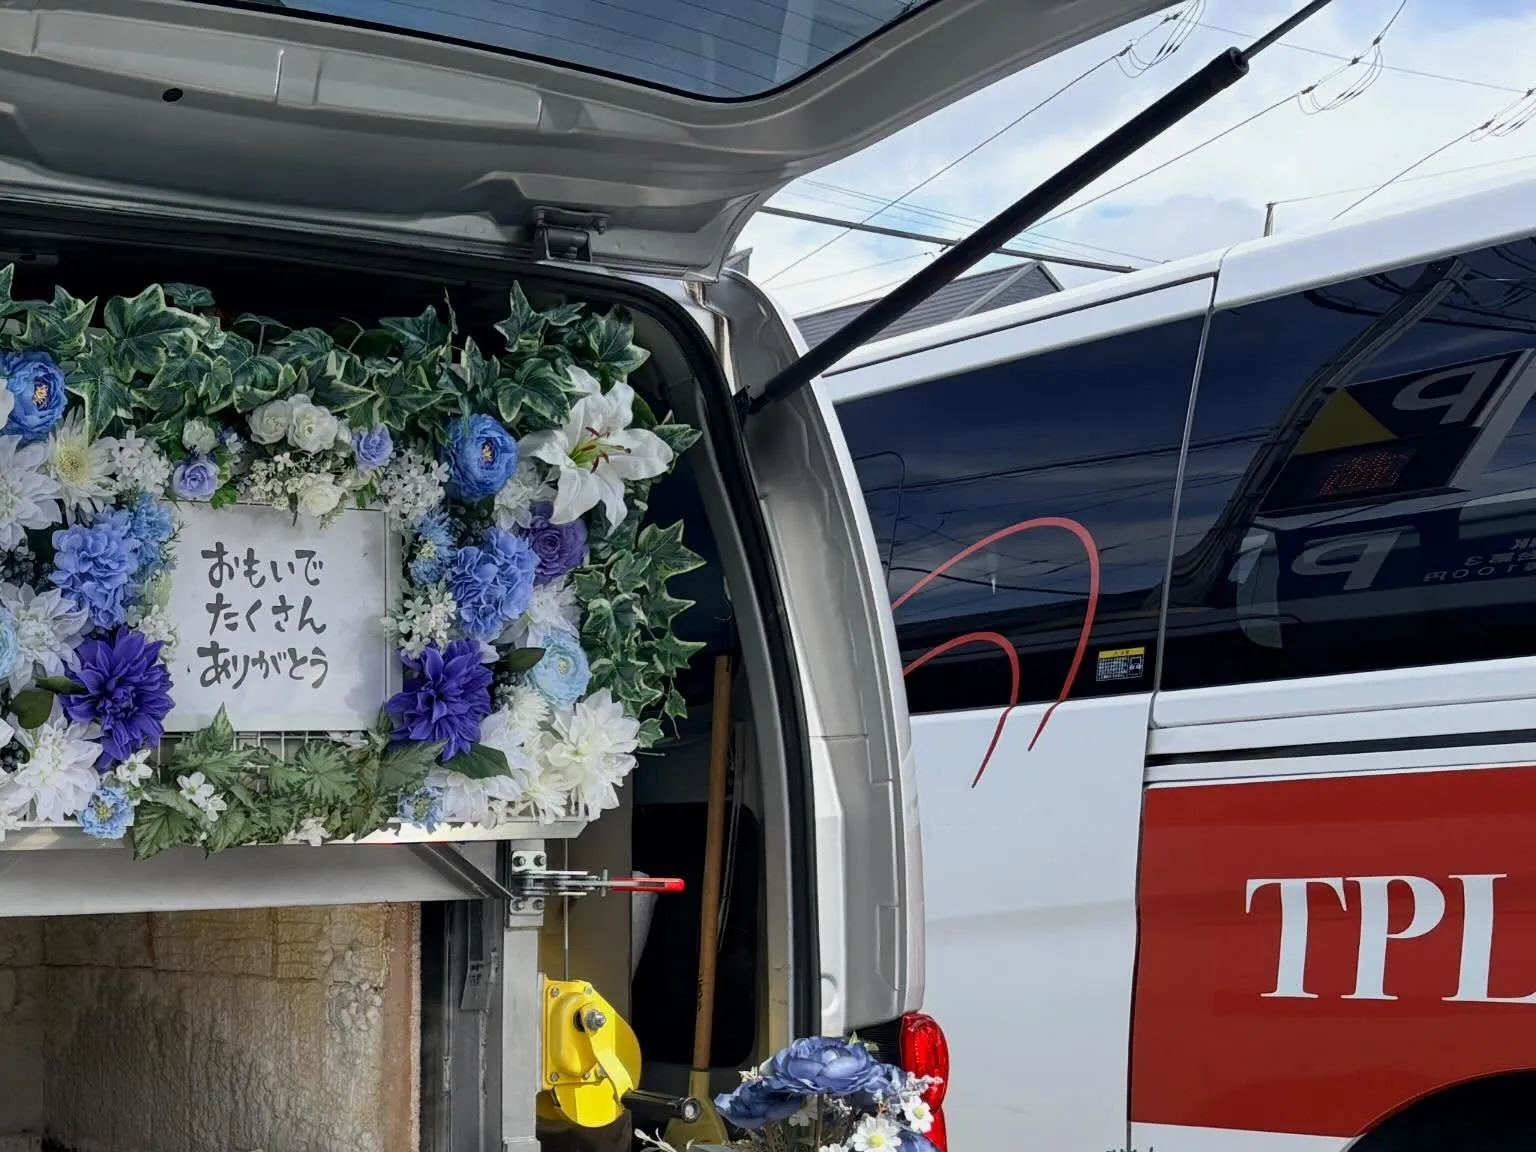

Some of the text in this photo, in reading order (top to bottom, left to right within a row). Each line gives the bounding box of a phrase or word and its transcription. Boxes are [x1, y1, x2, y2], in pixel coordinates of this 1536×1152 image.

[201, 541, 324, 588] おもいで
[205, 592, 327, 636] たくさん
[196, 641, 329, 690] ありがとう
[1246, 874, 1536, 1004] TPL
